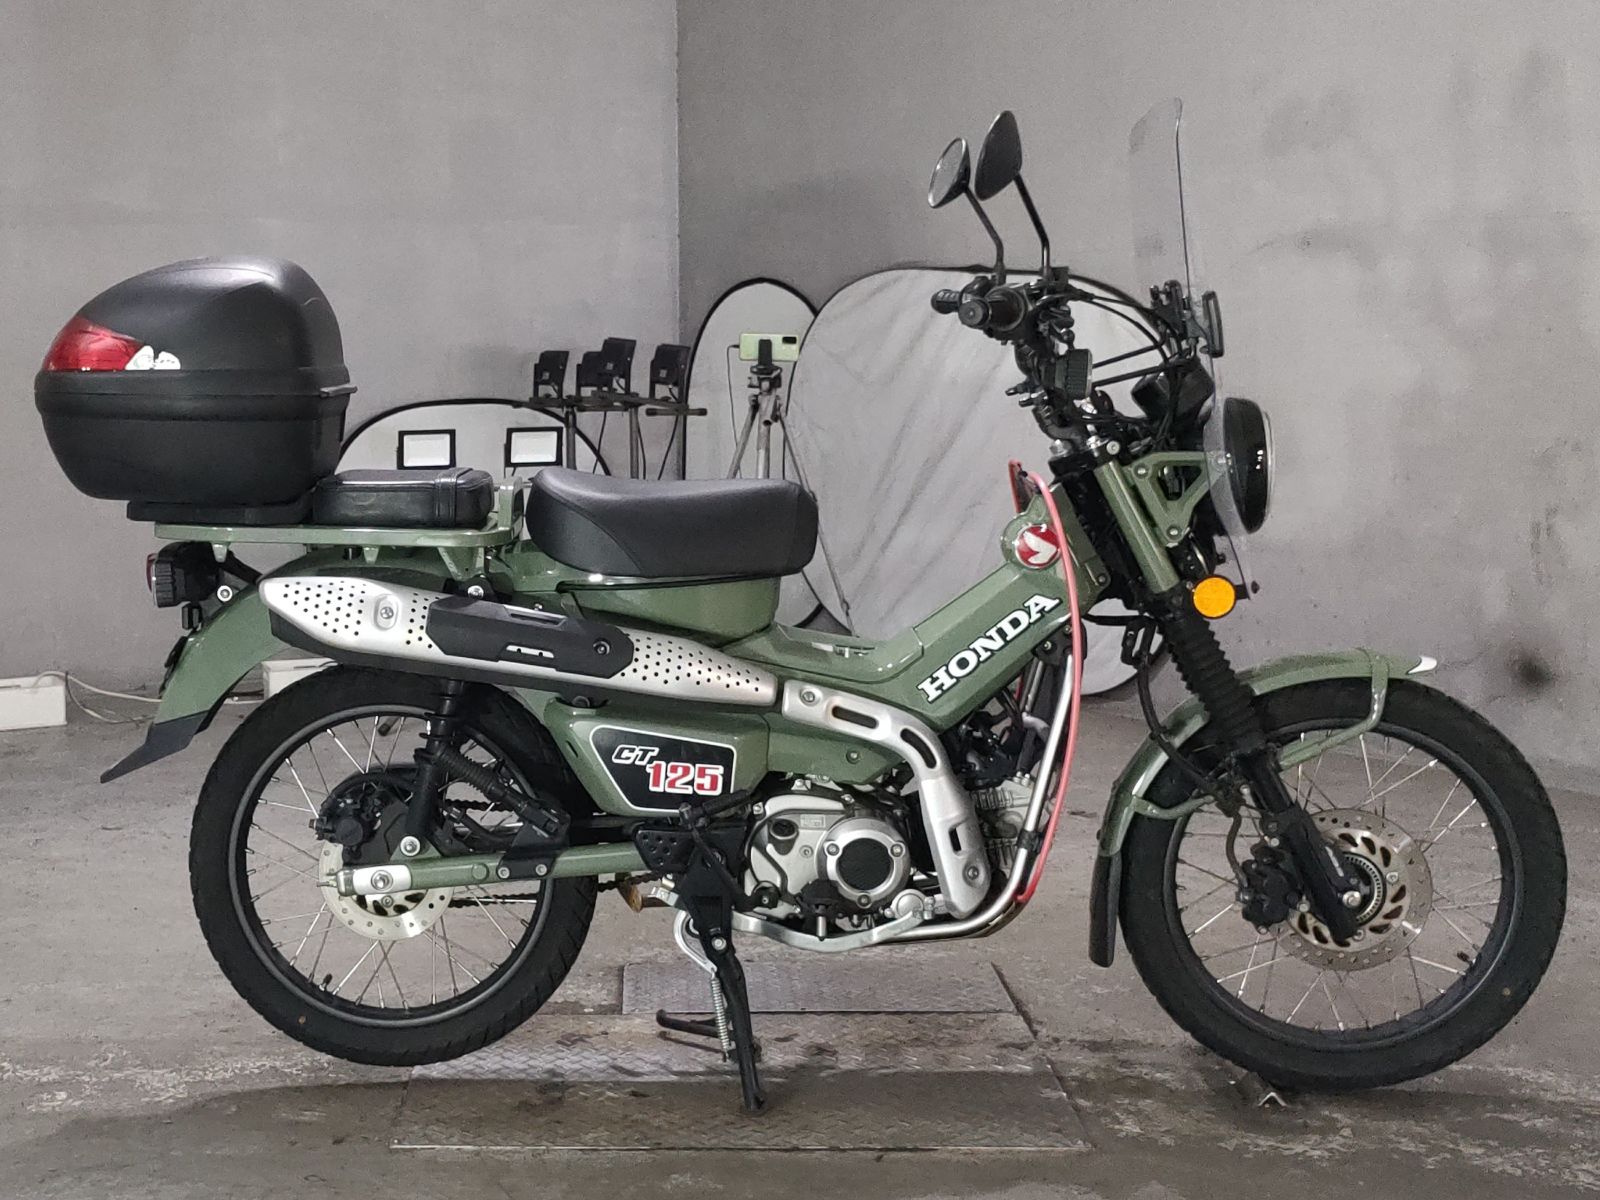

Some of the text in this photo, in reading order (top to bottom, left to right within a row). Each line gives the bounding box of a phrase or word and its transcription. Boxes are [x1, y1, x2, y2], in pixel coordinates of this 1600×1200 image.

[917, 594, 1061, 703] HONDA
[612, 744, 659, 765] CT
[646, 760, 724, 796] 125
